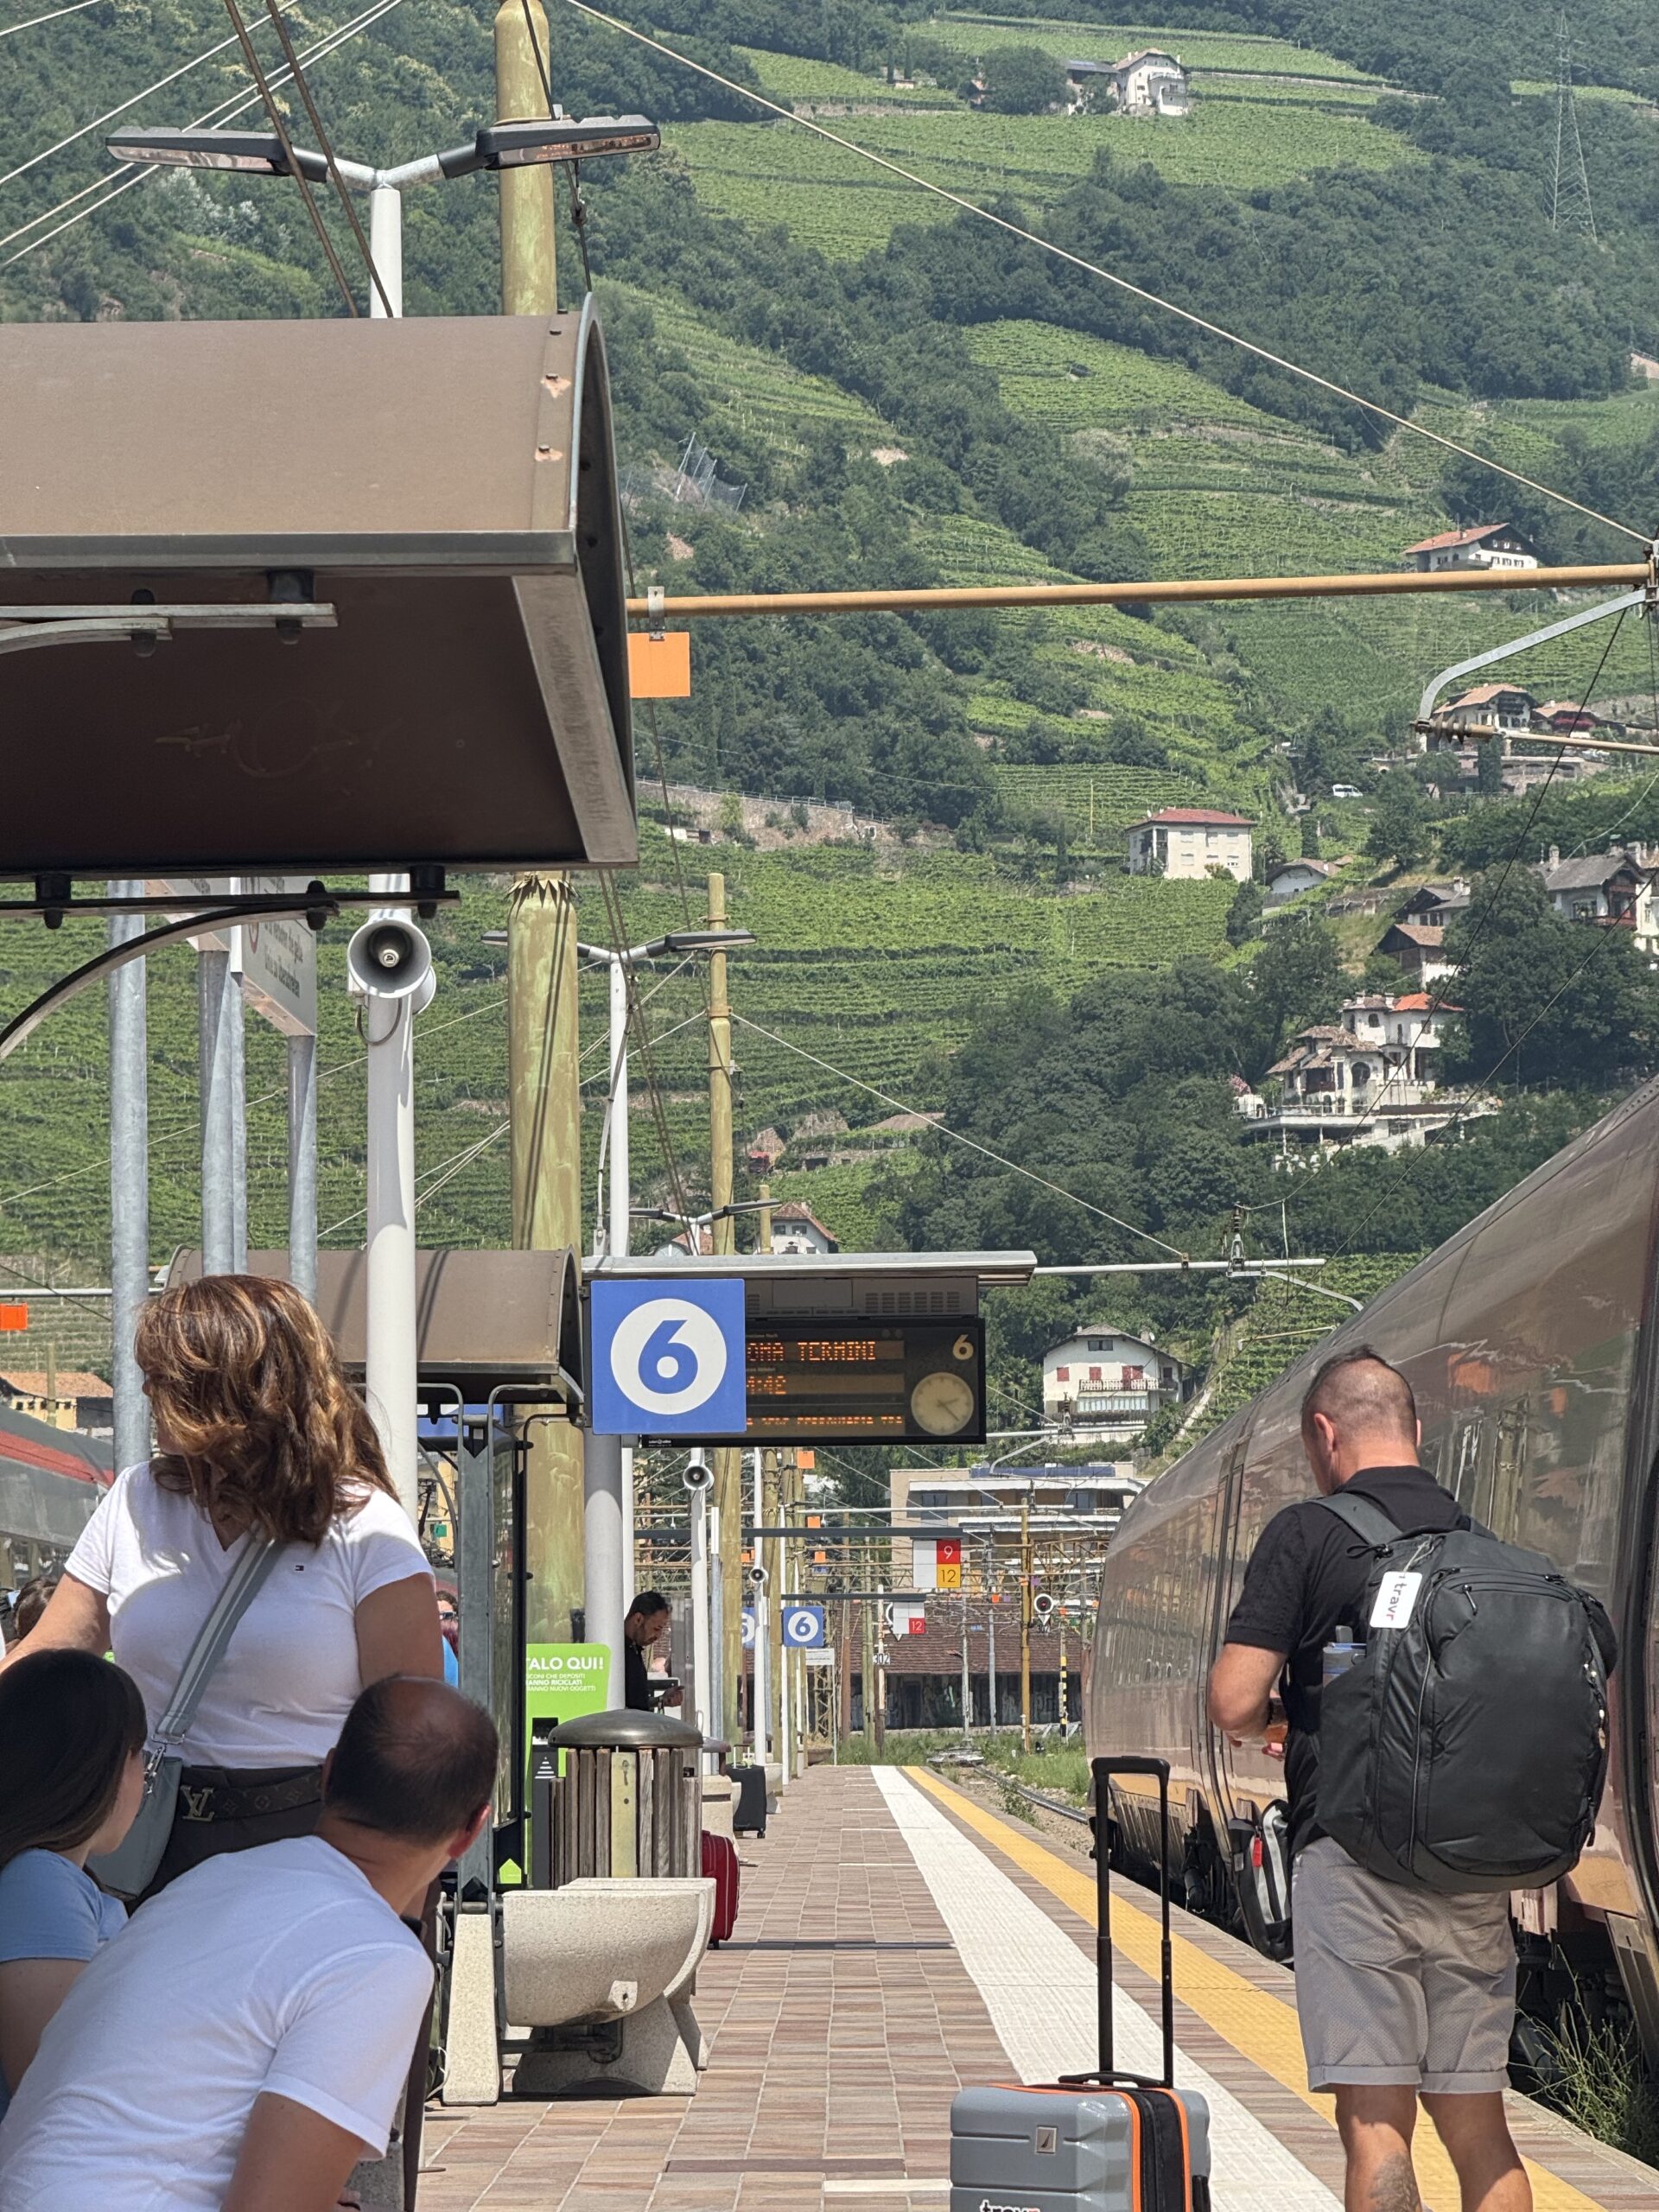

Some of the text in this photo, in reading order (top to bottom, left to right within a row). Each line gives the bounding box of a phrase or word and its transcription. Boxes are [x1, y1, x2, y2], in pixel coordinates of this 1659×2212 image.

[747, 1343, 784, 1362] OMA
[953, 1333, 974, 1361] 6
[638, 1319, 698, 1395] 6
[746, 1376, 787, 1395] 4:42
[944, 1545, 953, 1560] 9
[941, 1569, 957, 1583] 12
[795, 1616, 811, 1637] 6
[912, 1620, 922, 1631] 12
[566, 1656, 604, 1670] QUI!
[874, 1653, 890, 1664] 302
